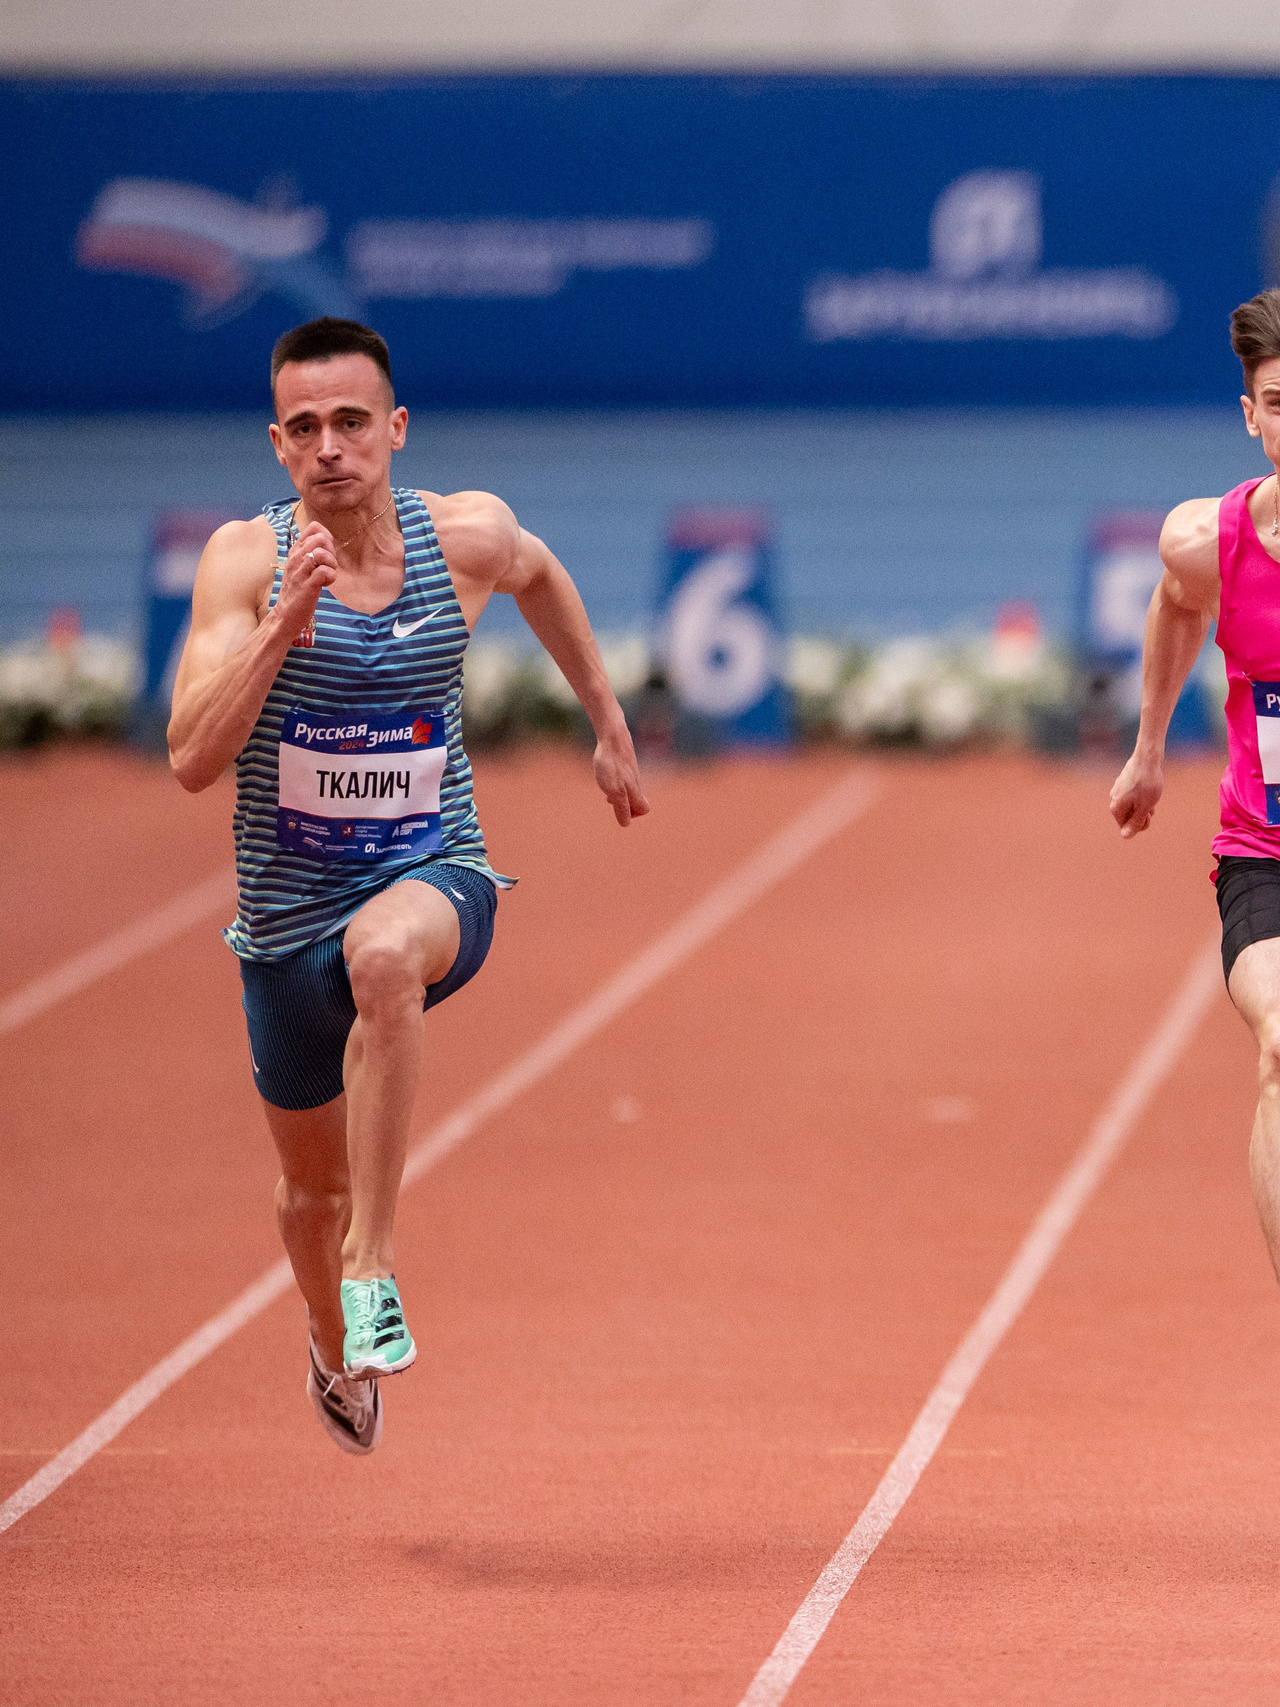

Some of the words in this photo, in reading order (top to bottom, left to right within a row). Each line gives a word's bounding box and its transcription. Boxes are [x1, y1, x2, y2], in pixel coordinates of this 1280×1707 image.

[668, 551, 768, 716] 6
[294, 722, 368, 743] Русская
[366, 726, 413, 748] Зима
[338, 739, 365, 751] 2024
[316, 769, 411, 799] ТКАЛИЧ
